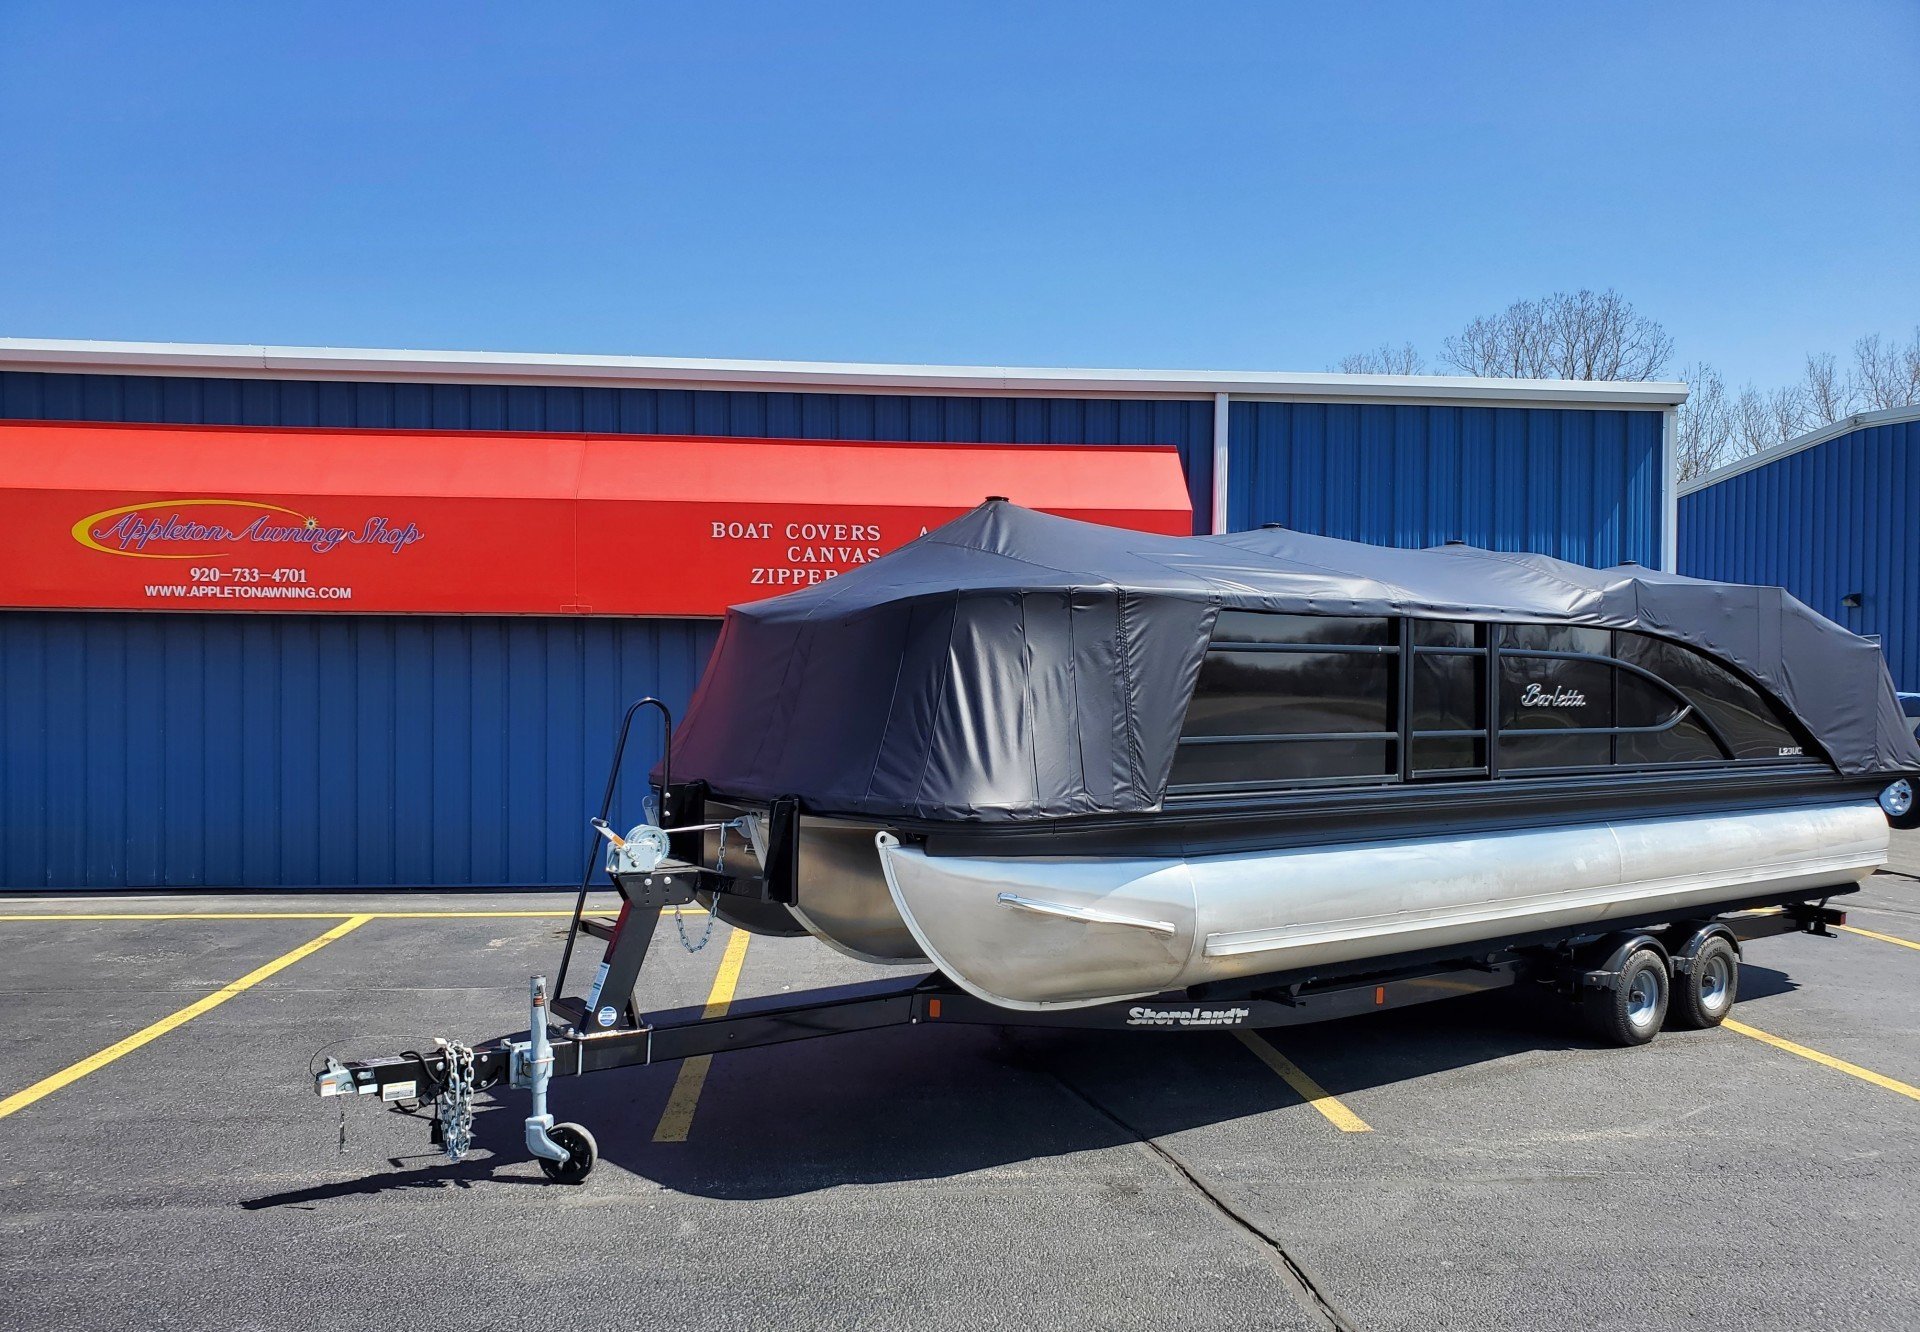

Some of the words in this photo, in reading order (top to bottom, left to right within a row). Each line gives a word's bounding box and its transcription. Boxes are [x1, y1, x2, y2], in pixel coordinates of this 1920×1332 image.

[93, 512, 228, 549] Appleton
[226, 515, 347, 553] Awning
[349, 516, 424, 553] Shop
[711, 522, 773, 539] BOAT
[786, 523, 881, 541] COVERS
[787, 546, 881, 563] CANVAS
[190, 567, 307, 583] 920-733-4701
[145, 585, 352, 599] WWW.APPLETONAWNING.COM
[1521, 683, 1586, 706] Barletta
